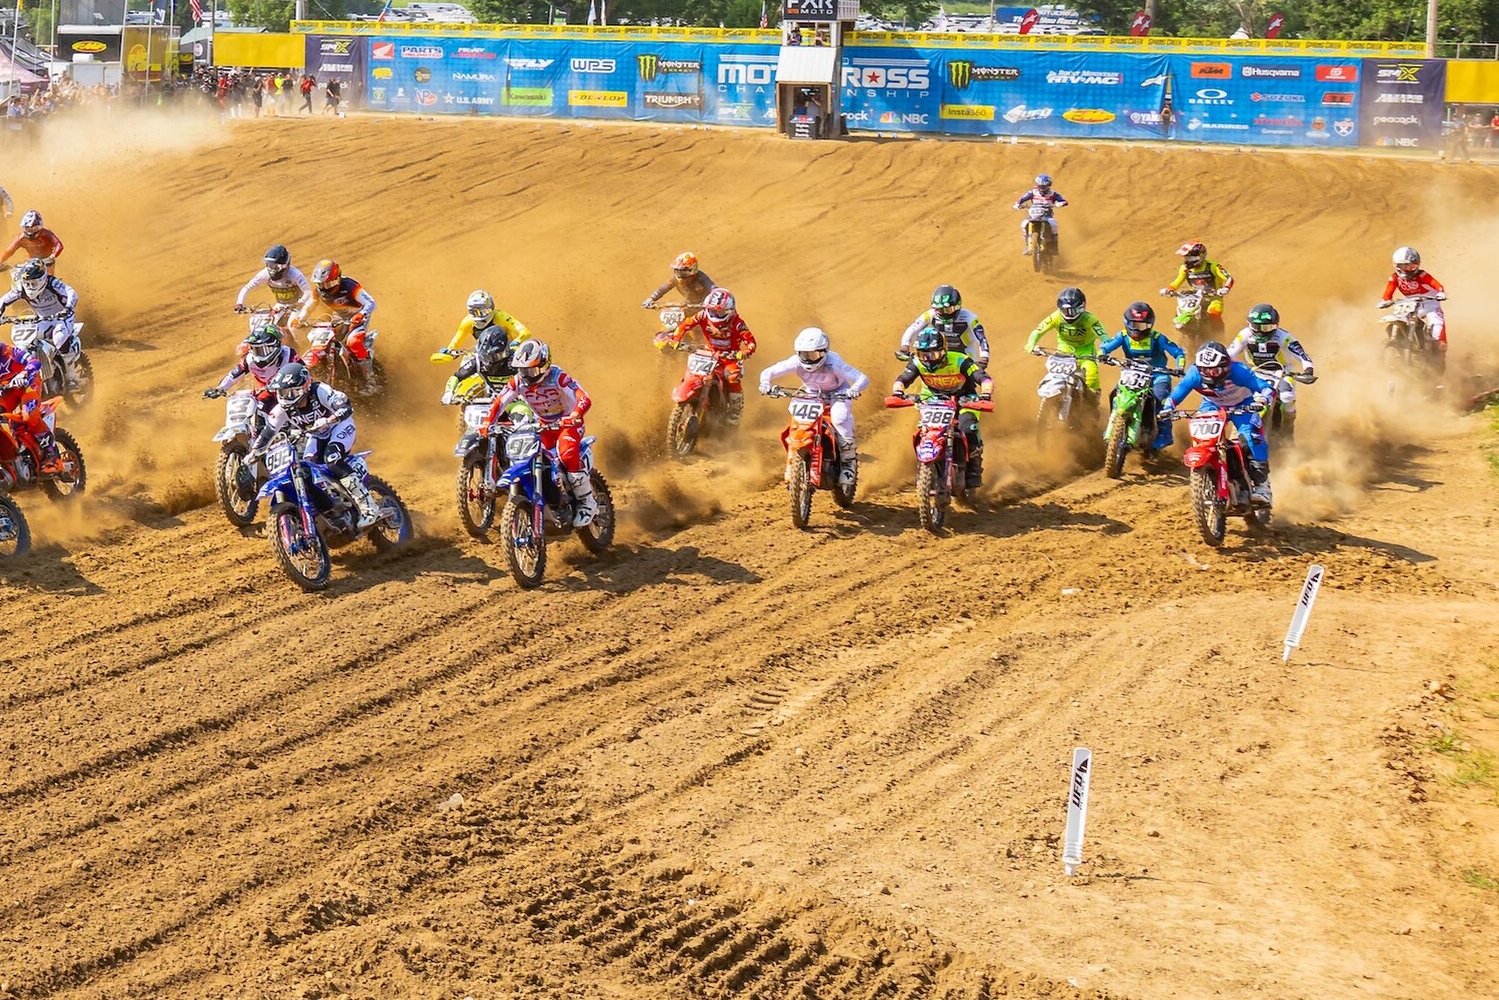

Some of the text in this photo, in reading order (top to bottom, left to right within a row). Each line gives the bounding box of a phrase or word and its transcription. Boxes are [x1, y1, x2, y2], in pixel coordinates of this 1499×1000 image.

[572, 60, 614, 72] WPS
[658, 61, 699, 69] MONSTER
[972, 67, 1018, 75] MONSTER
[1199, 67, 1224, 75] KTM
[1252, 68, 1299, 77] Husqvarna
[1377, 67, 1421, 80] SMX
[453, 73, 495, 81] NAMURA
[718, 64, 930, 89] MO ROSS
[718, 85, 930, 98] CHA NSHIP
[645, 95, 691, 104] TRIUMPH
[841, 111, 868, 120] cock
[948, 108, 986, 116] Insta360
[902, 114, 928, 124] NBC
[1140, 114, 1176, 122] YAMA
[1373, 115, 1418, 126] peacock
[1395, 138, 1418, 147] NBC
[1182, 299, 1197, 309] 78
[13, 329, 37, 341] 27
[1050, 361, 1074, 375] 233
[925, 376, 962, 386] ONEAL
[792, 403, 821, 420] 146
[924, 411, 952, 424] 388
[1192, 422, 1221, 436] 700
[1302, 581, 1314, 606] UFO
[1072, 772, 1083, 808] UFO
